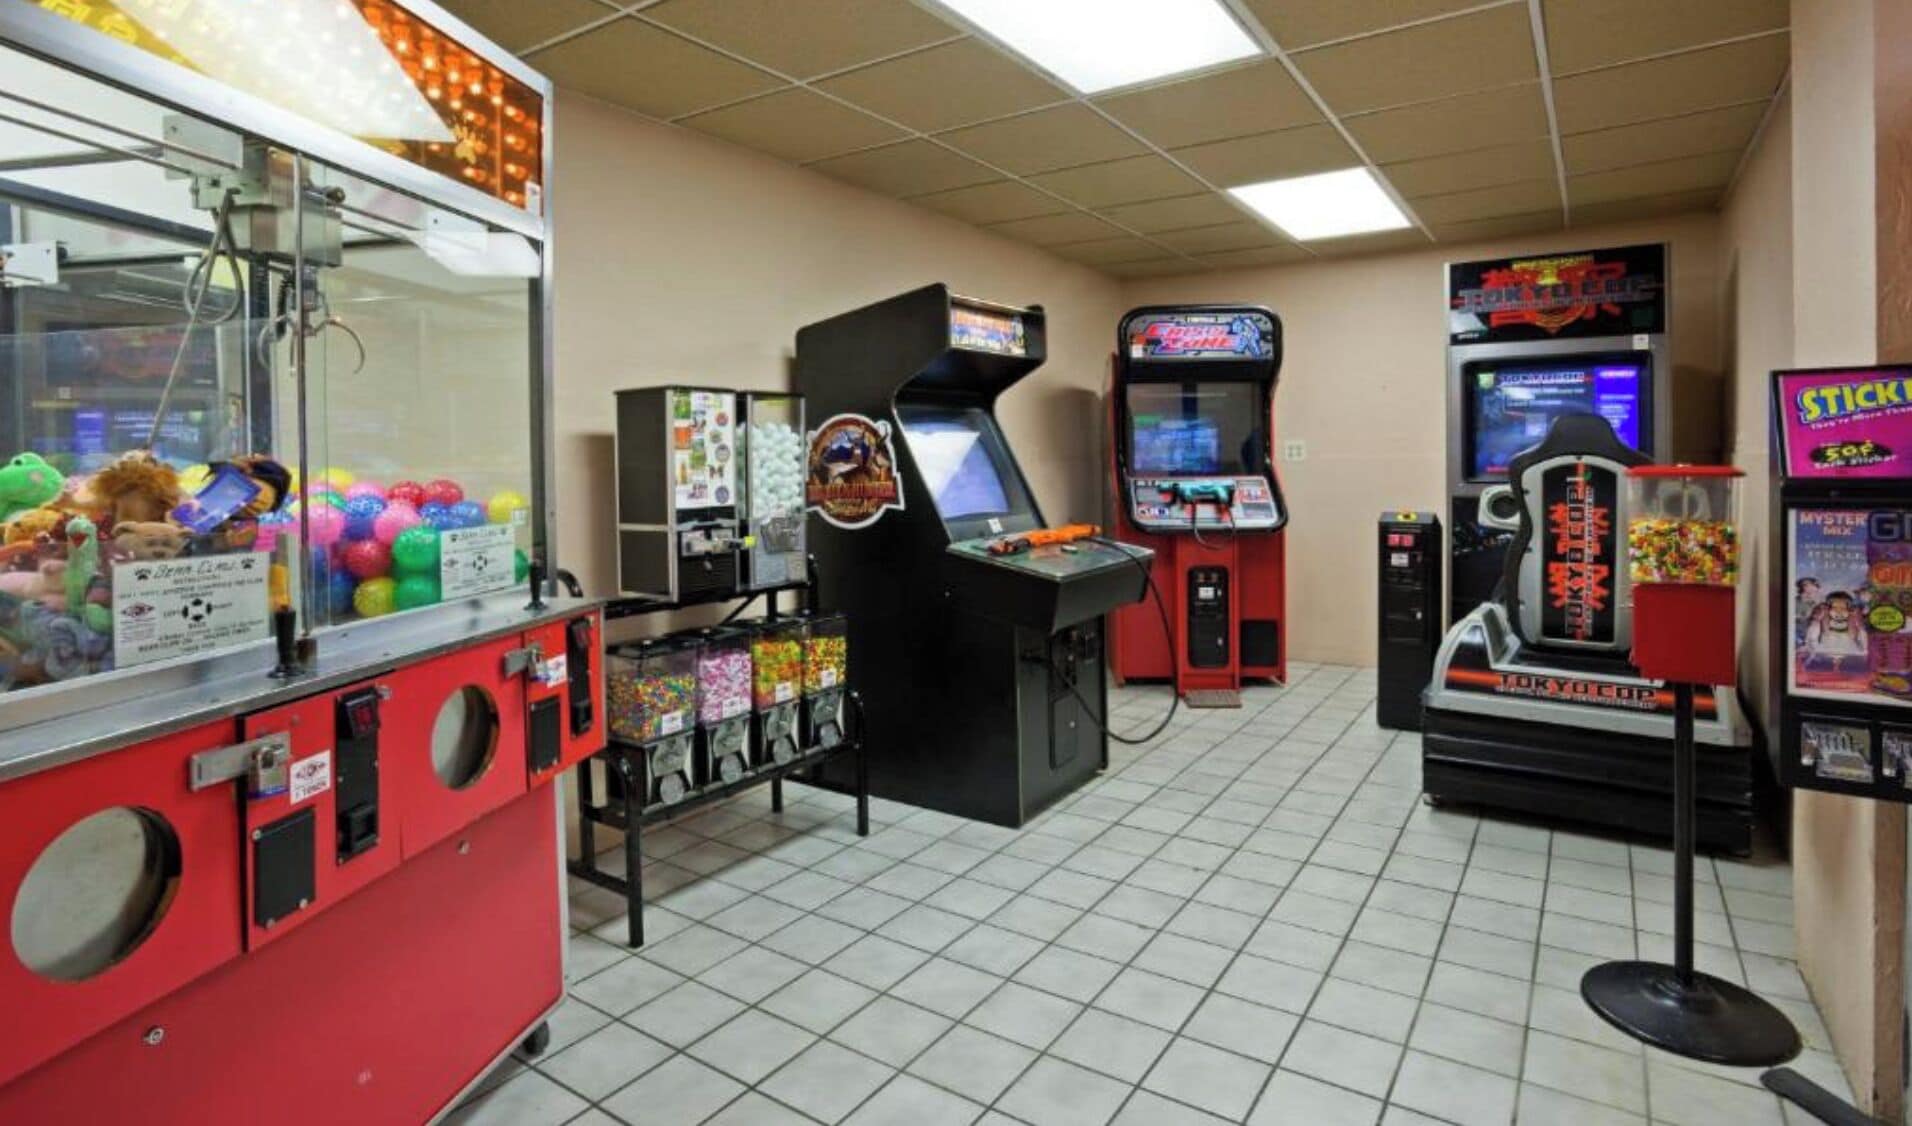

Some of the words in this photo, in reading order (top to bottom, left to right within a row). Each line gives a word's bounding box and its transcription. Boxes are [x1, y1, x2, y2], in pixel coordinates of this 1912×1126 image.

[1457, 282, 1573, 310] TOKYO
[1579, 273, 1658, 298] COP
[1825, 439, 1874, 462] 50¢
[1566, 481, 1585, 544] COP
[154, 565, 192, 579] BEAR
[1566, 546, 1585, 635] TOKYO
[1500, 673, 1589, 694] TOKYO
[1592, 681, 1656, 702] COP
